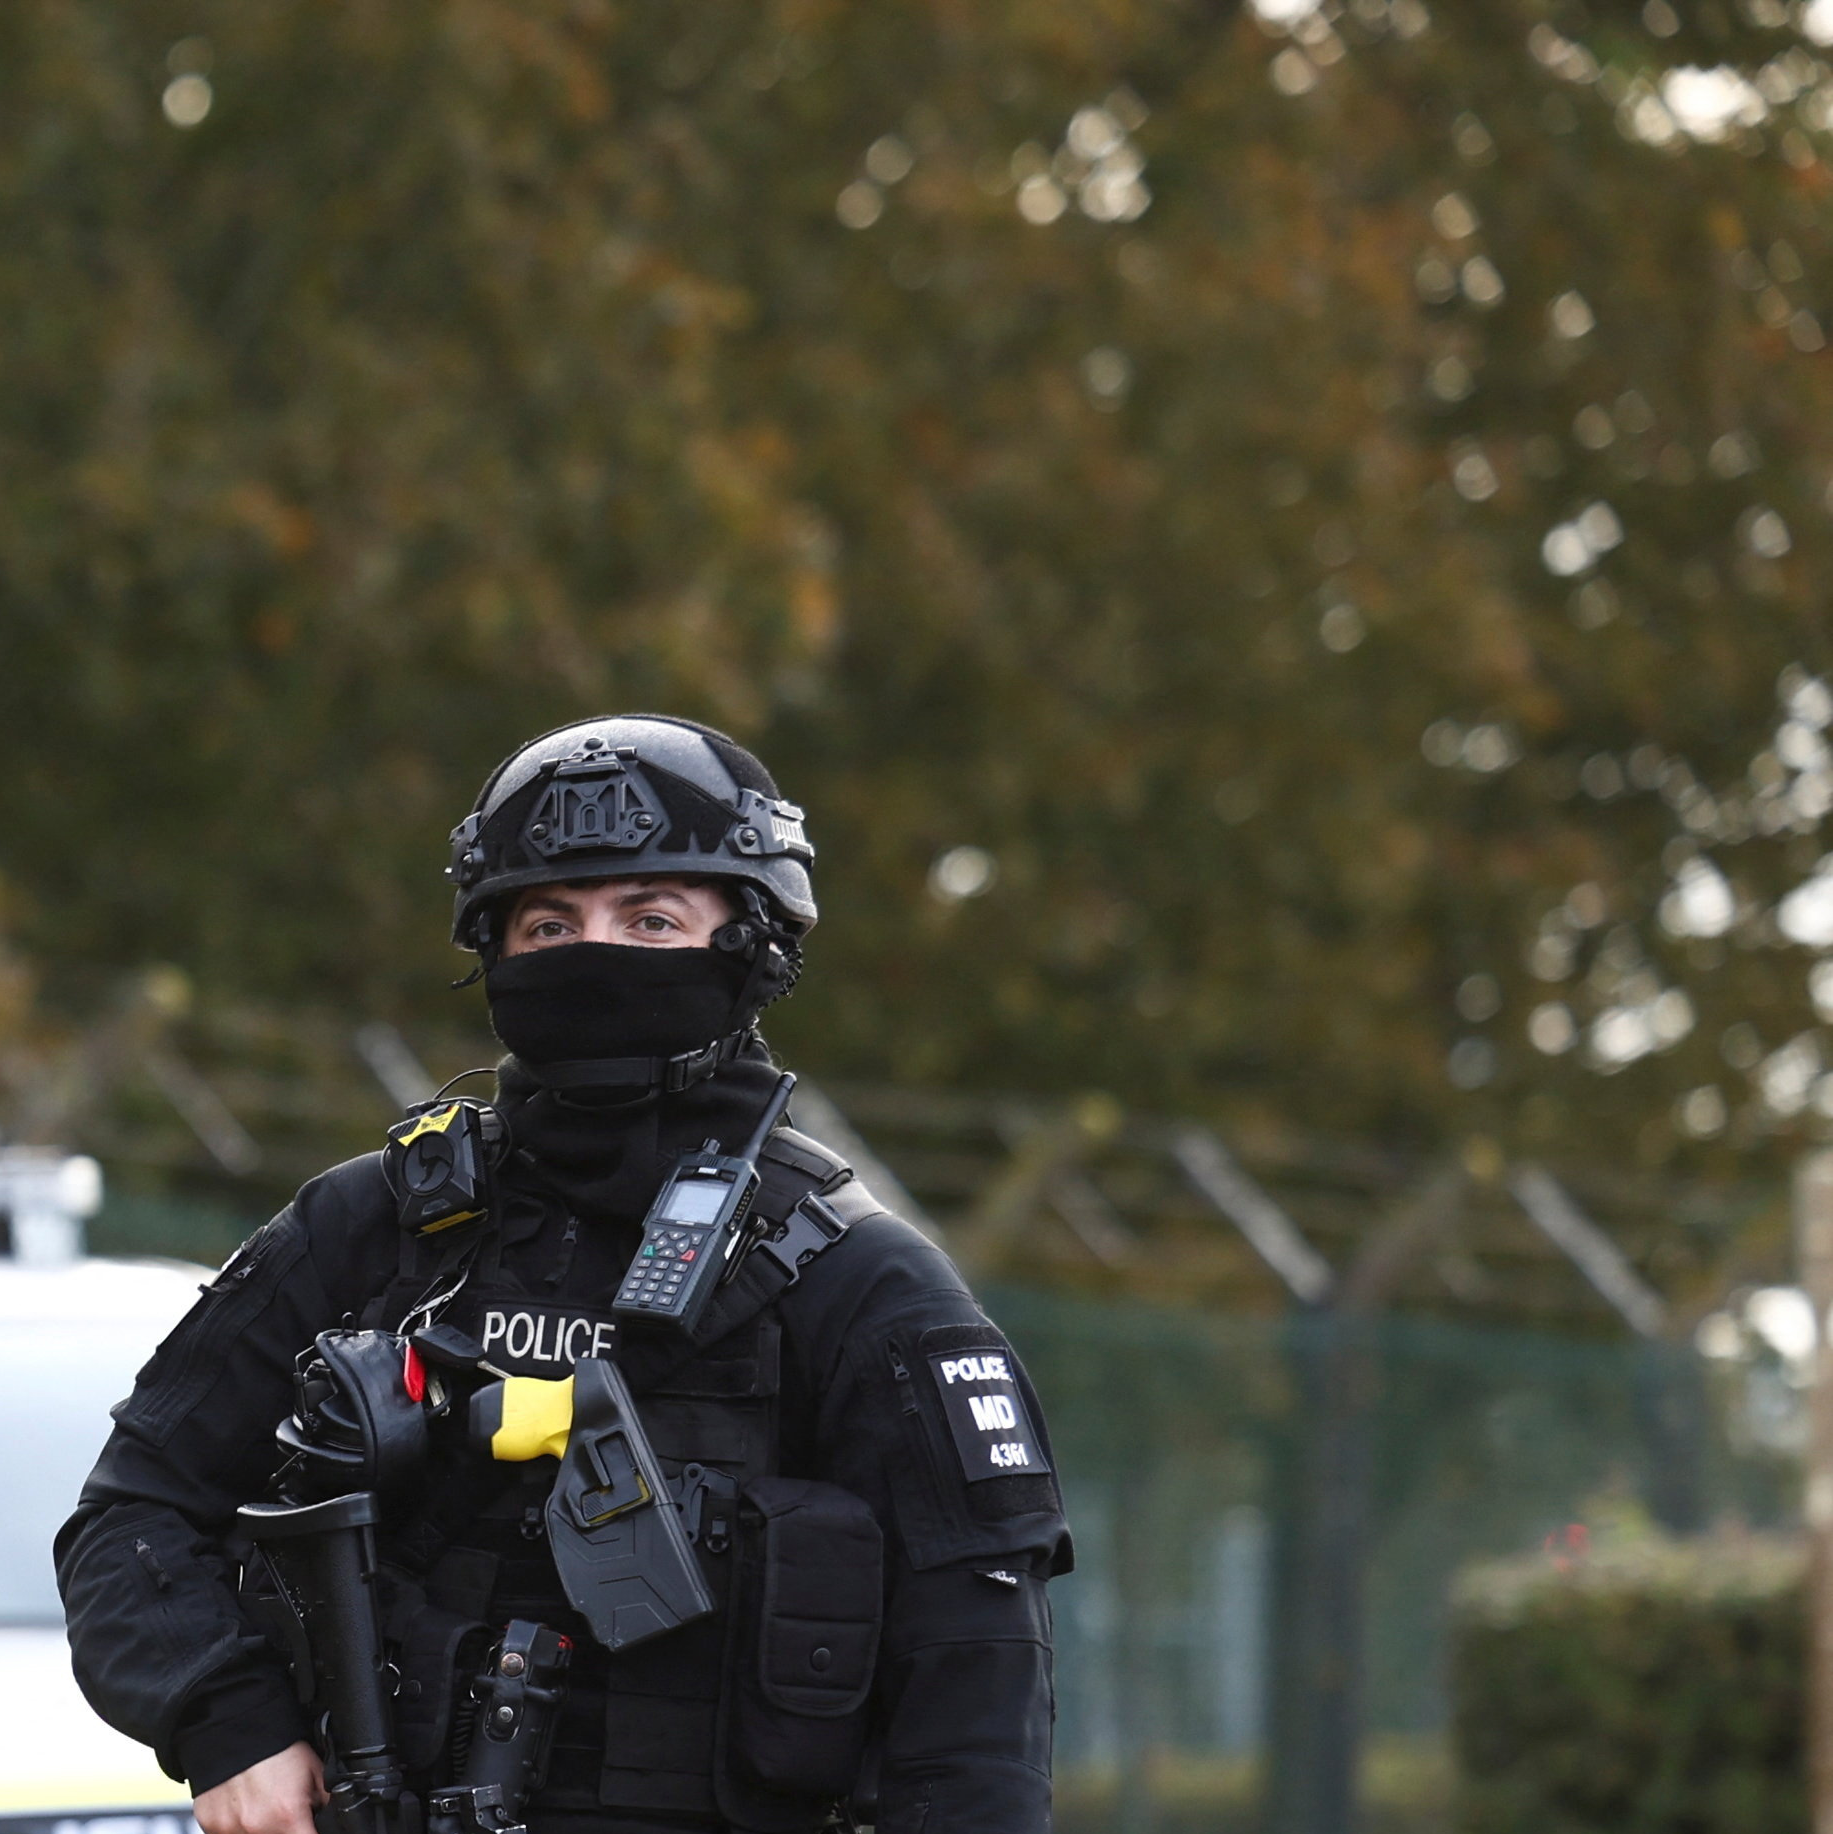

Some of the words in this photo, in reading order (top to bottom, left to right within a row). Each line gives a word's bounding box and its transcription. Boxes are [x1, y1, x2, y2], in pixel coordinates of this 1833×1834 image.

[482, 1311, 616, 1365] POLICE
[940, 1356, 1013, 1384] POLICE
[968, 1395, 1016, 1431] MD
[990, 1443, 1029, 1467] 4361
